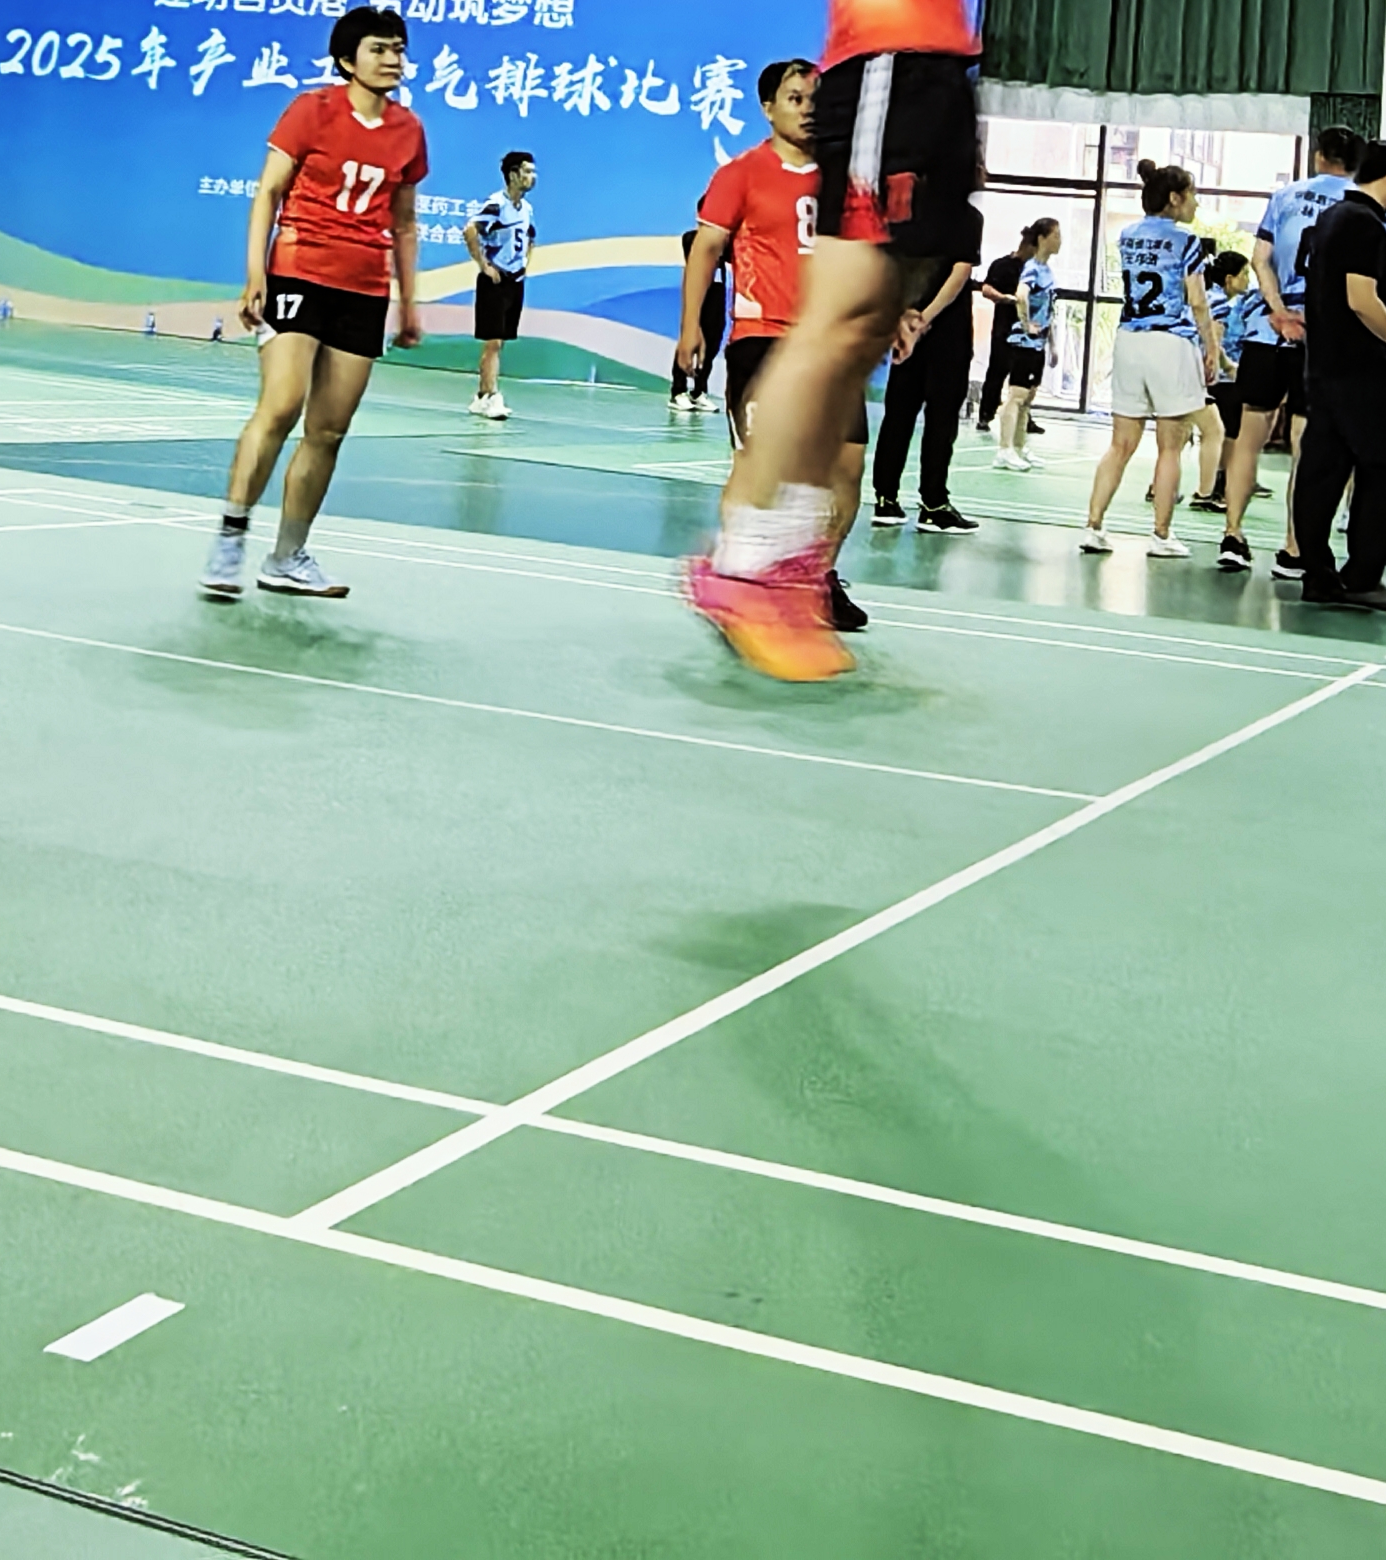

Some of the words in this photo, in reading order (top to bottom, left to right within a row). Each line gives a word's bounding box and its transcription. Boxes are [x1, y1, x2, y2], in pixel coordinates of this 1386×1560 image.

[0, 25, 748, 136] 2025年产业工气排球比赛
[335, 159, 385, 215] 17
[514, 228, 524, 252] 5
[276, 293, 304, 320] 17
[1122, 269, 1165, 318] 12
